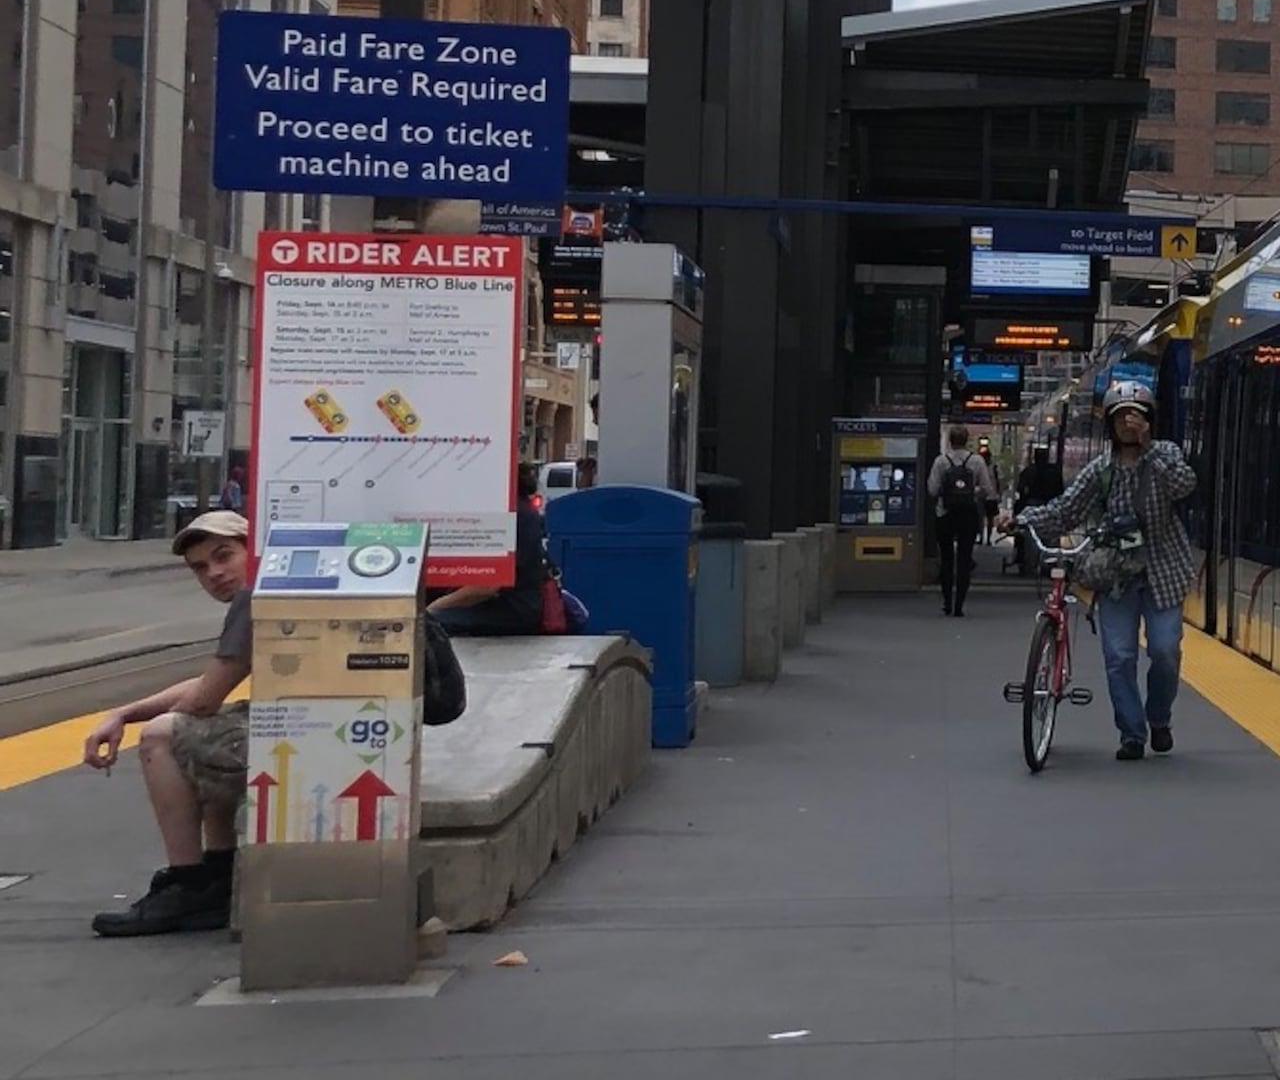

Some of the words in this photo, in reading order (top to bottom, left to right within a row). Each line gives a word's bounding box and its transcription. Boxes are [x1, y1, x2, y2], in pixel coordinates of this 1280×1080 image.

[283, 29, 346, 58] Paid
[359, 33, 425, 62] Fare
[436, 36, 517, 66] Zone
[245, 63, 320, 92] Valid
[332, 68, 399, 96] Fare
[411, 71, 547, 106] Required
[257, 111, 388, 142] Proceed
[401, 122, 434, 145] to
[446, 123, 533, 148] ticket
[279, 152, 409, 180] machine
[421, 157, 511, 183] ahead
[496, 203, 510, 215] of
[510, 204, 556, 217] America
[507, 222, 522, 233] St.
[523, 222, 547, 233] Paul
[1070, 228, 1085, 239] to
[1086, 226, 1124, 243] Target
[1126, 228, 1154, 242] Field
[306, 241, 402, 266] RIDER
[411, 244, 510, 268] ALERT
[266, 274, 327, 289] Closure
[330, 275, 375, 292] along
[379, 276, 439, 291] METRO
[444, 278, 478, 292] Blue
[482, 278, 514, 292] Line
[351, 718, 389, 744] go
[369, 737, 388, 749] to
